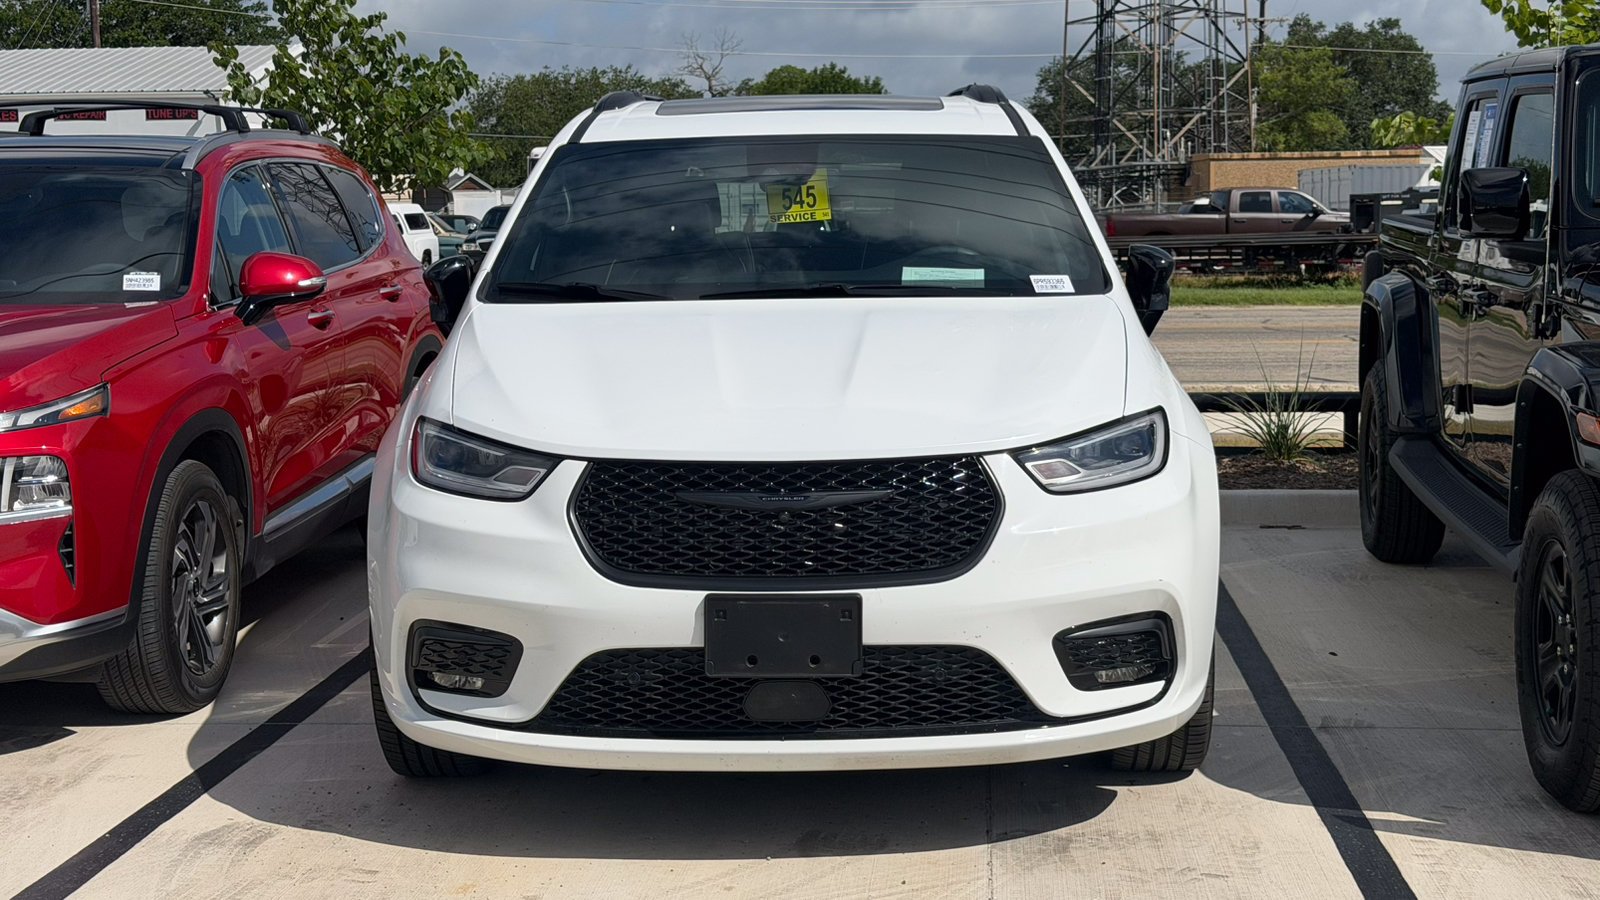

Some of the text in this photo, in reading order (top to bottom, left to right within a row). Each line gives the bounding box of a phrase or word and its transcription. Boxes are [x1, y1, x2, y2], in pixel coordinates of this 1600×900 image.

[147, 109, 197, 119] TUNE UP'S
[782, 185, 817, 211] 545
[770, 211, 817, 222] SERVICE
